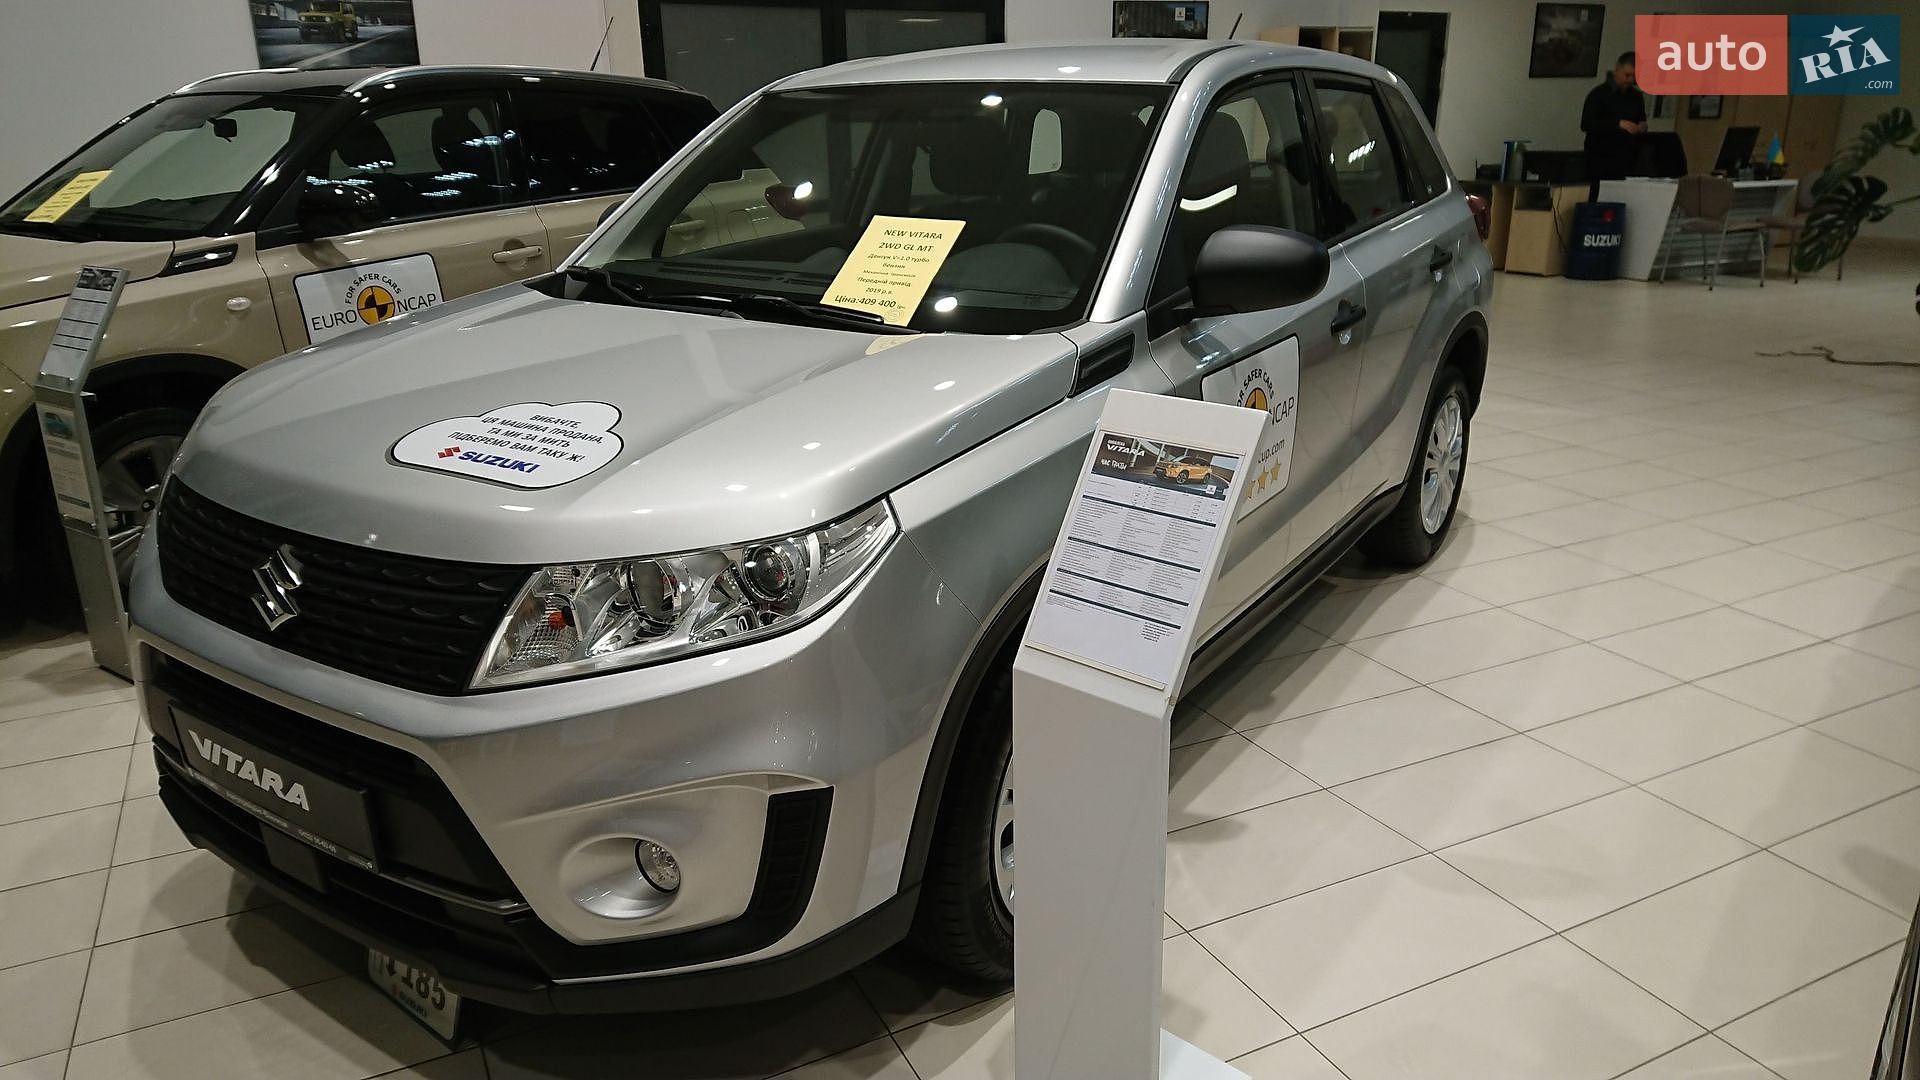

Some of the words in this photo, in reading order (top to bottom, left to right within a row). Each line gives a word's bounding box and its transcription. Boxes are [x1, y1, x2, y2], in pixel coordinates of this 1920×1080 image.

[878, 242, 902, 250] 2WD
[884, 229, 908, 238] NEW
[908, 230, 943, 240] VITARA
[1583, 234, 1622, 247] SUZUKI
[345, 286, 356, 304] FOR
[353, 273, 380, 287] SAFER
[381, 275, 402, 295] CARS
[311, 309, 358, 331] EURO
[396, 293, 437, 313] NCAP
[878, 300, 896, 308] 400
[1236, 390, 1245, 407] OR
[1243, 368, 1263, 390] SAFER
[1263, 371, 1275, 399] CARS
[481, 416, 498, 425] ЦЯ
[497, 418, 547, 433] МАШИНА
[548, 426, 605, 445] ПРОДАНА,
[529, 414, 582, 429] ВИБАЧТЕ,
[448, 431, 511, 448] ПІДБЕРЕМО
[509, 442, 536, 453] ВАМ
[538, 447, 567, 459] ТАКУ
[566, 452, 586, 463] Ж!
[486, 427, 502, 435] ТА
[504, 429, 521, 439] МИ
[521, 432, 537, 442] ЗА
[537, 436, 571, 448] МИТЬ
[1106, 443, 1146, 457] VITARA
[1257, 439, 1285, 463] up.com
[458, 451, 541, 474] SUZUKI
[188, 729, 310, 812] VITARA
